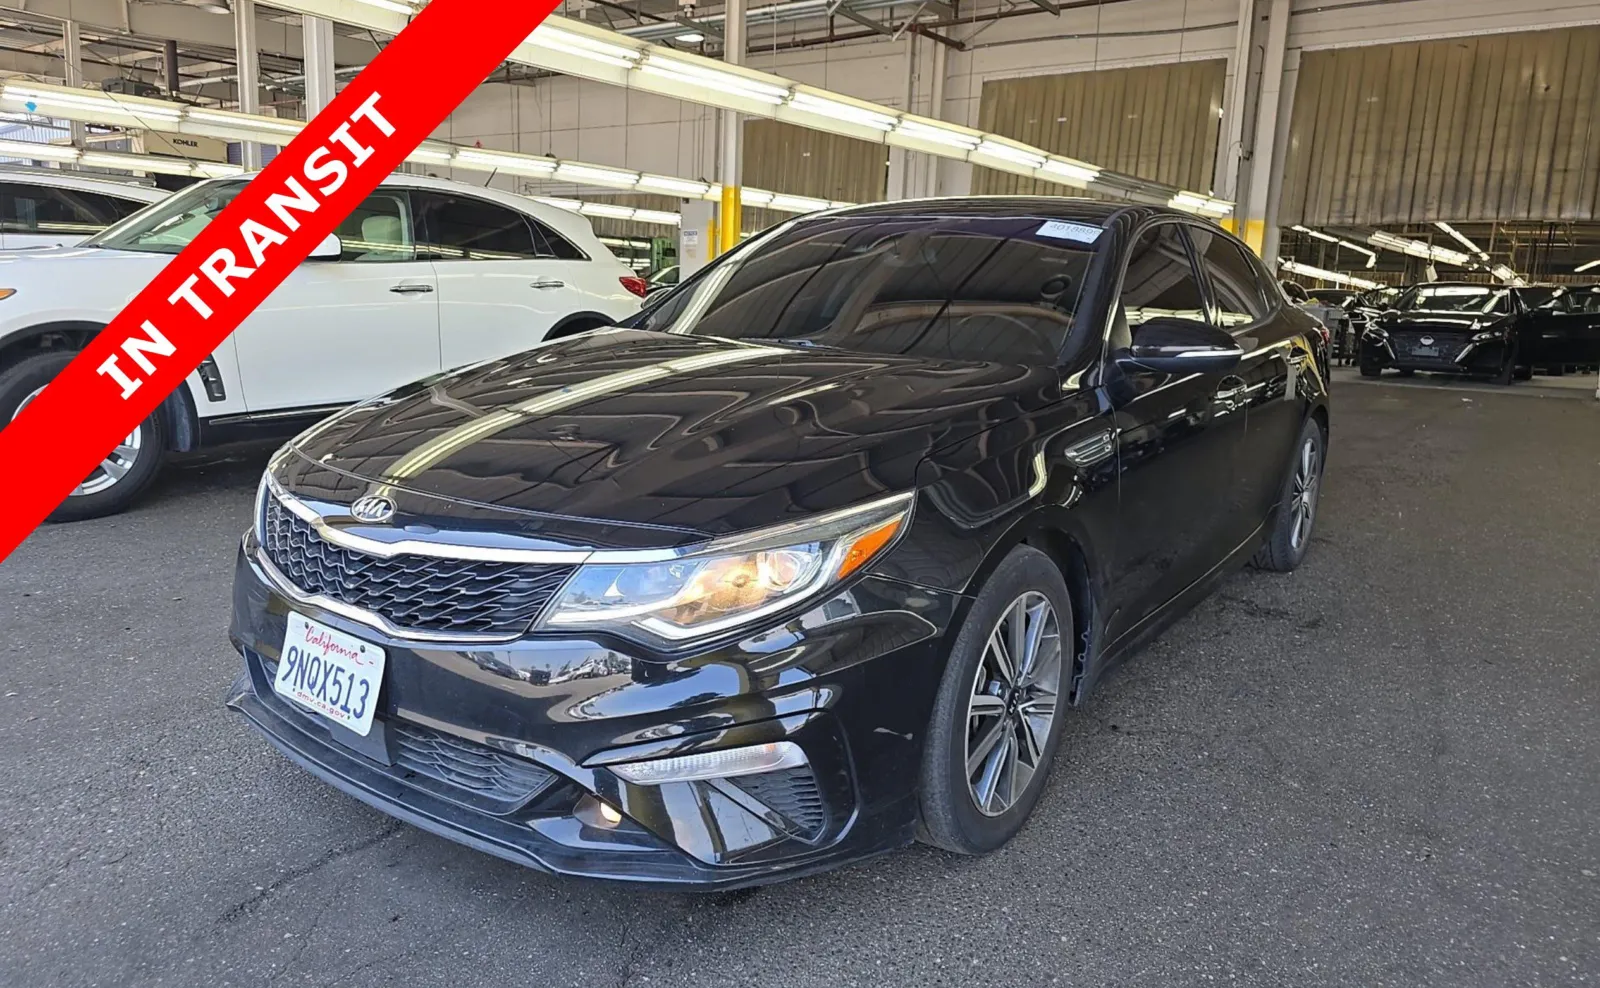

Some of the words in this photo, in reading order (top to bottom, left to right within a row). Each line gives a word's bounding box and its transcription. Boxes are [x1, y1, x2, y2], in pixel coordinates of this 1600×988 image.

[172, 138, 199, 148] KOHLER
[305, 625, 364, 665] California
[281, 645, 370, 719] 9NQX513
[296, 691, 345, 718] dmv.ca.gov
